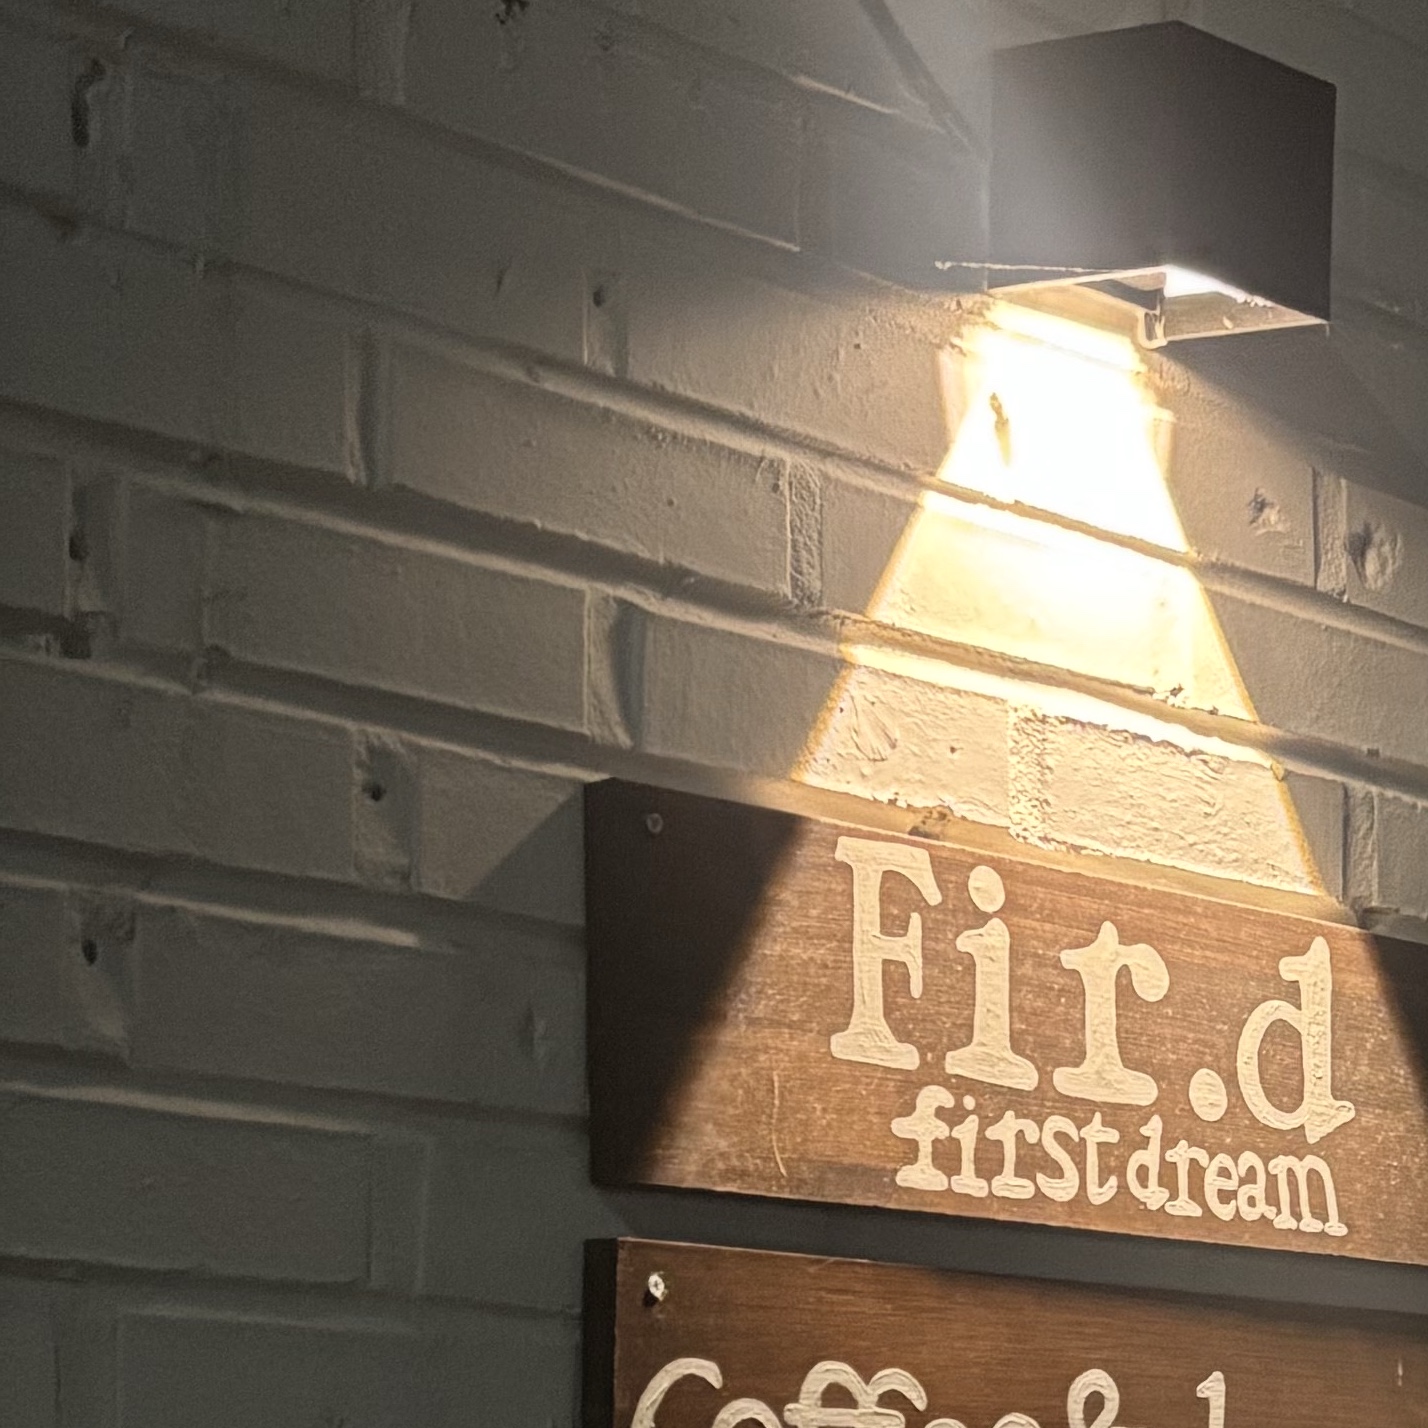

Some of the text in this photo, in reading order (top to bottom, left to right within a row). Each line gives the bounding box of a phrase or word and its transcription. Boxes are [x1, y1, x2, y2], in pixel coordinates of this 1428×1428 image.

[829, 835, 1357, 1143] Fir.d
[890, 1085, 1349, 1237] first dream
